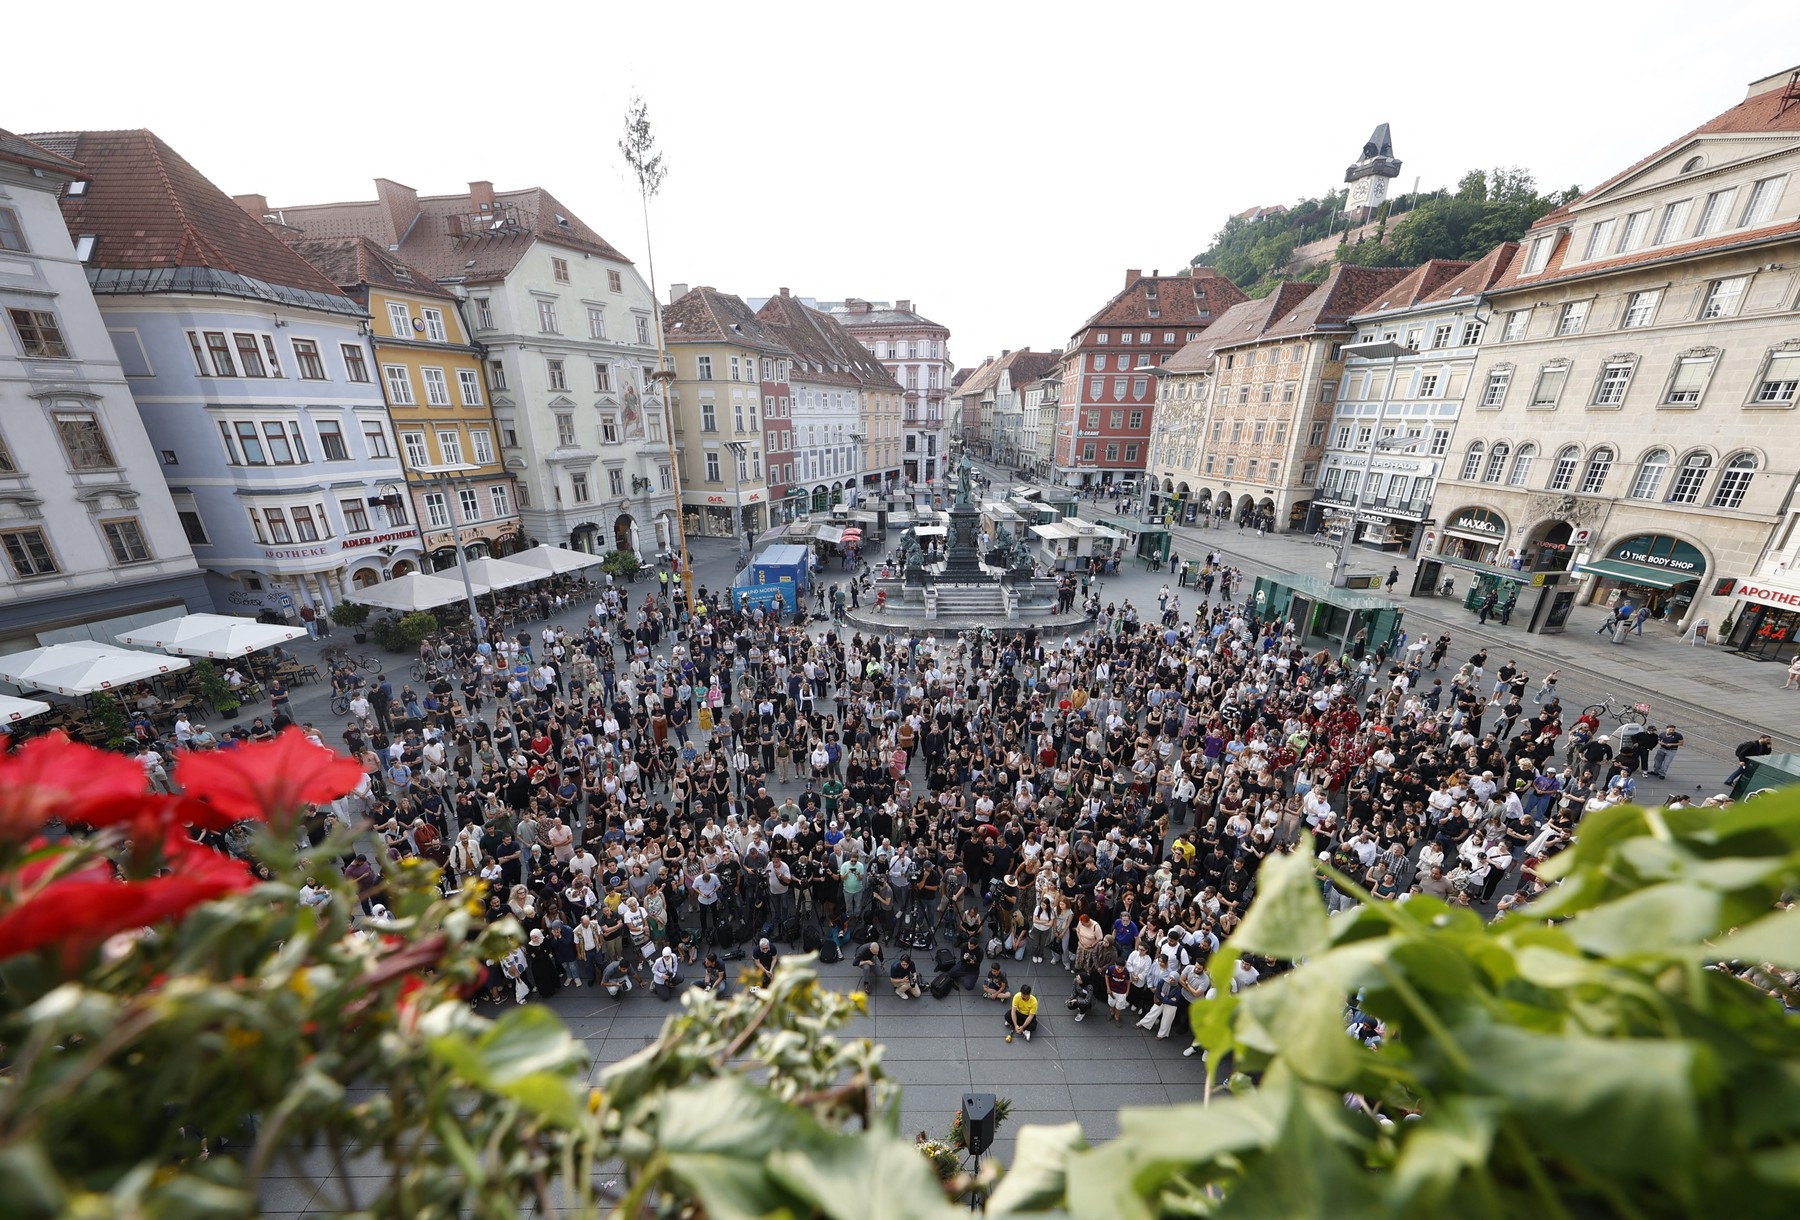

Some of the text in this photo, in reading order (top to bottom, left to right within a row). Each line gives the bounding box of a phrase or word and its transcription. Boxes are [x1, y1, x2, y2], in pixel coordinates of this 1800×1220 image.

[1319, 498, 1351, 506] JUWELIER
[1372, 505, 1422, 518] UHRENHAUS
[342, 530, 418, 549] ADLER APOTHEKE
[265, 547, 328, 559] APOTHEKE
[1631, 553, 1694, 570] THE BODY SHOP
[1738, 585, 1800, 606] APOTHE
